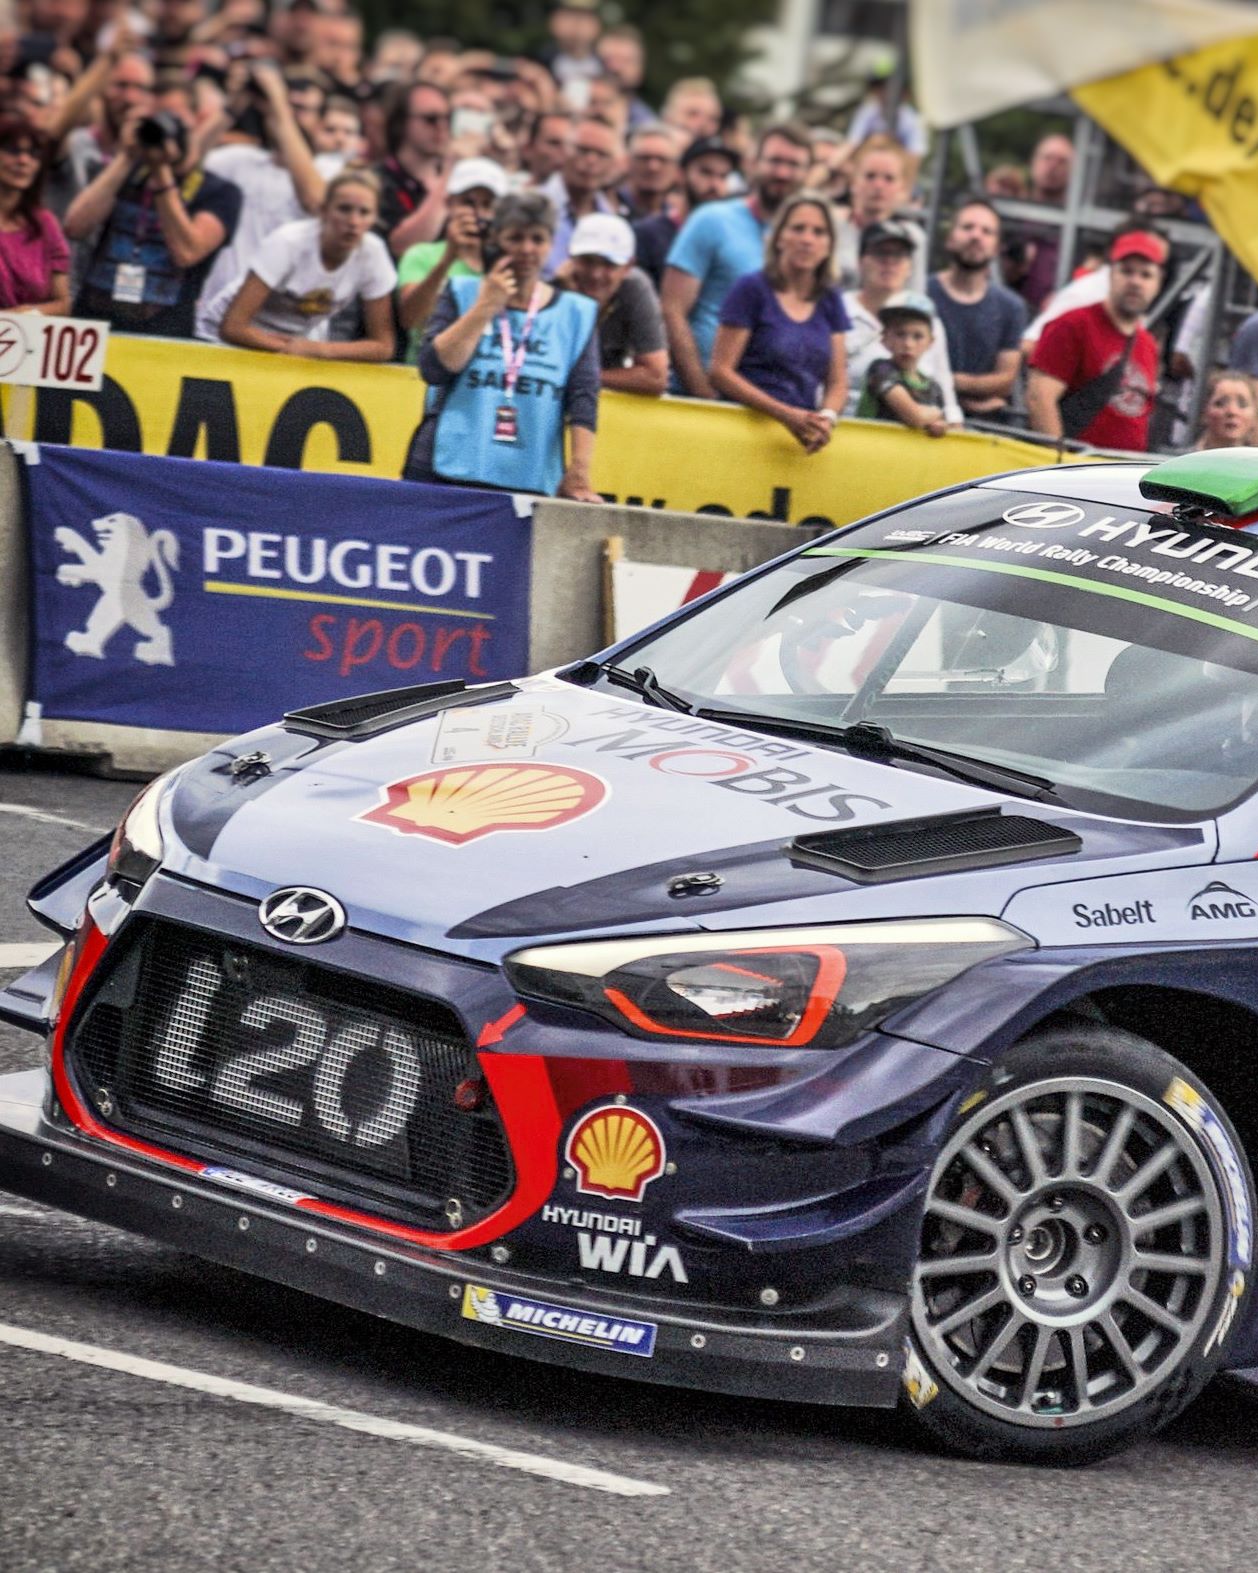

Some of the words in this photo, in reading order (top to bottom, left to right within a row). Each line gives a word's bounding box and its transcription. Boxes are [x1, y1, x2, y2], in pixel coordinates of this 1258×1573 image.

[41, 325, 98, 383] 102
[203, 527, 494, 599] PEUGEOT
[938, 532, 980, 547] FIA
[977, 535, 1045, 555] World
[1038, 541, 1100, 568] Rally
[1096, 552, 1253, 610] Championship
[304, 613, 494, 677] sport
[589, 707, 813, 762] HYUNDAI
[562, 728, 894, 822] MOBIS
[1072, 900, 1157, 928] Sabelt
[1190, 902, 1257, 921] AMG
[541, 1204, 643, 1237] HYUNDAI
[506, 1303, 646, 1345] MICHELIN
